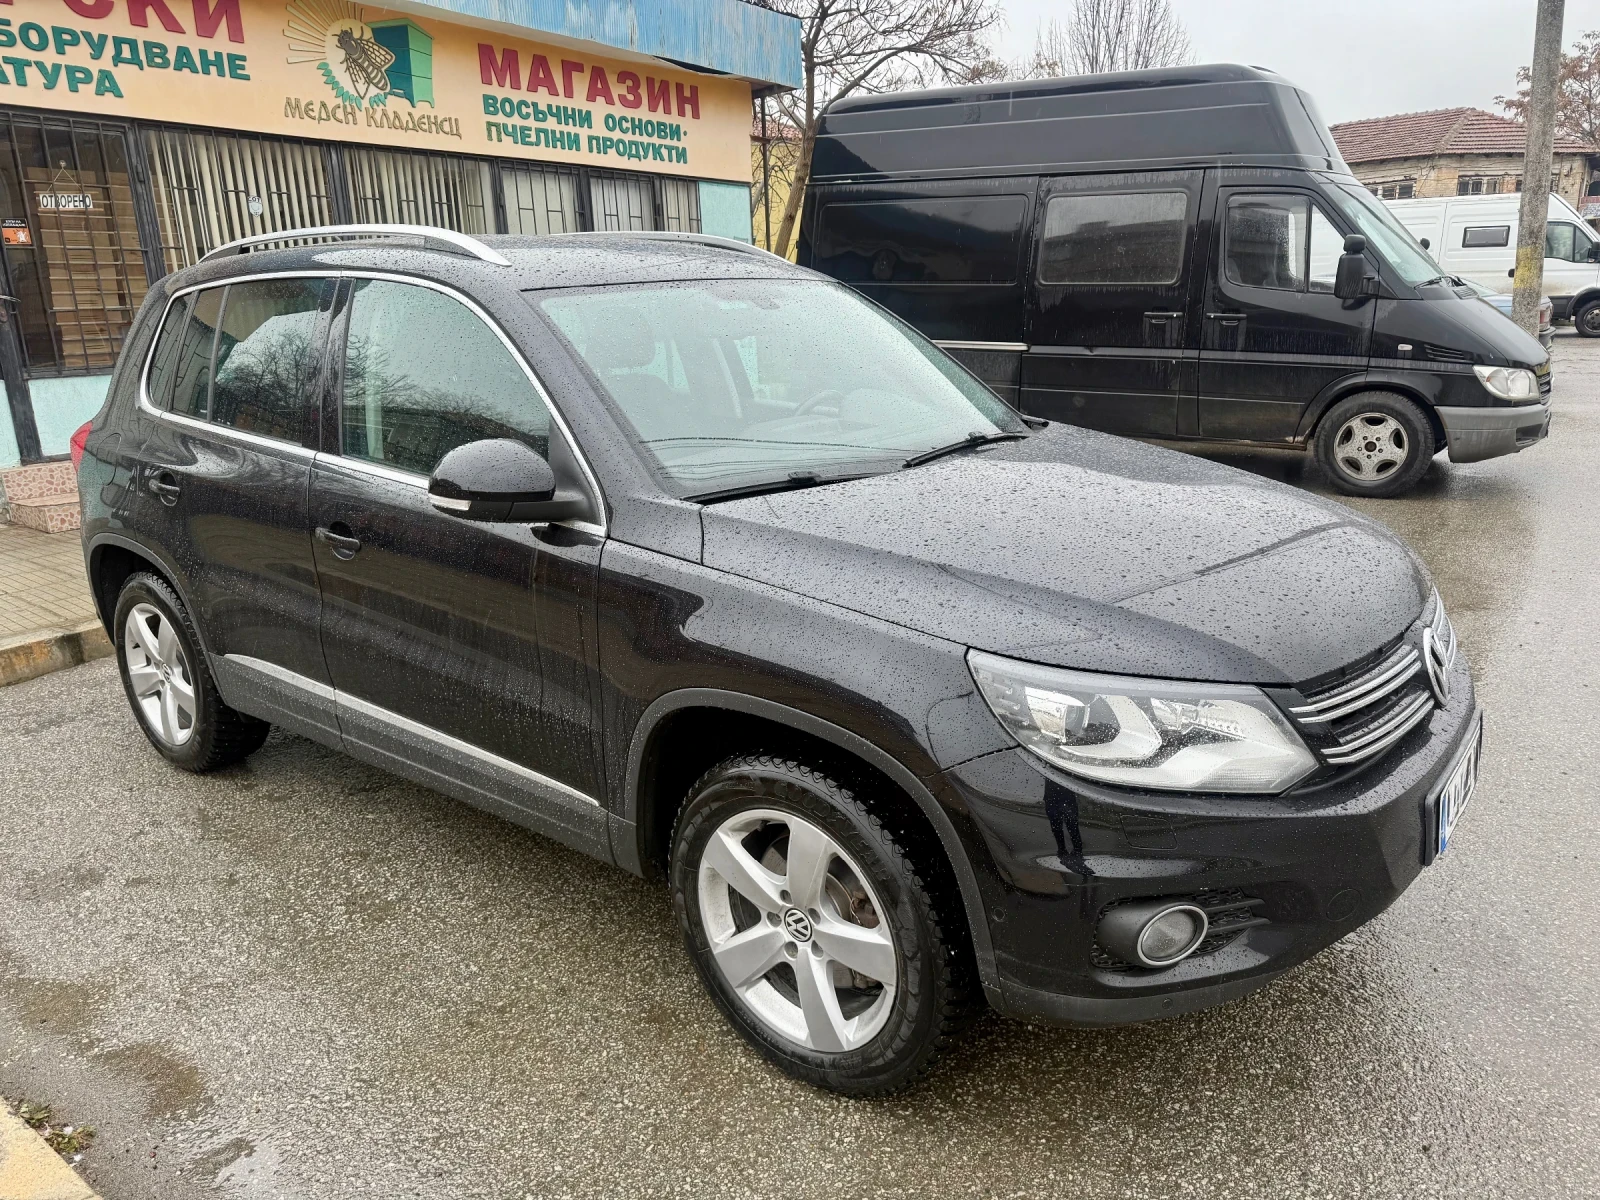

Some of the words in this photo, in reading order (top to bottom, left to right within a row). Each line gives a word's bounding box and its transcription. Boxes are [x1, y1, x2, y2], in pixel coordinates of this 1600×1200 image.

[477, 43, 701, 120] МАГАЗИН
[482, 93, 593, 130] ВОСЪЧНИ
[485, 120, 581, 152] ПЧЕЛНИ
[587, 134, 688, 165] ПРОДУКТИ
[41, 194, 92, 208] ОТВОРЕНО
